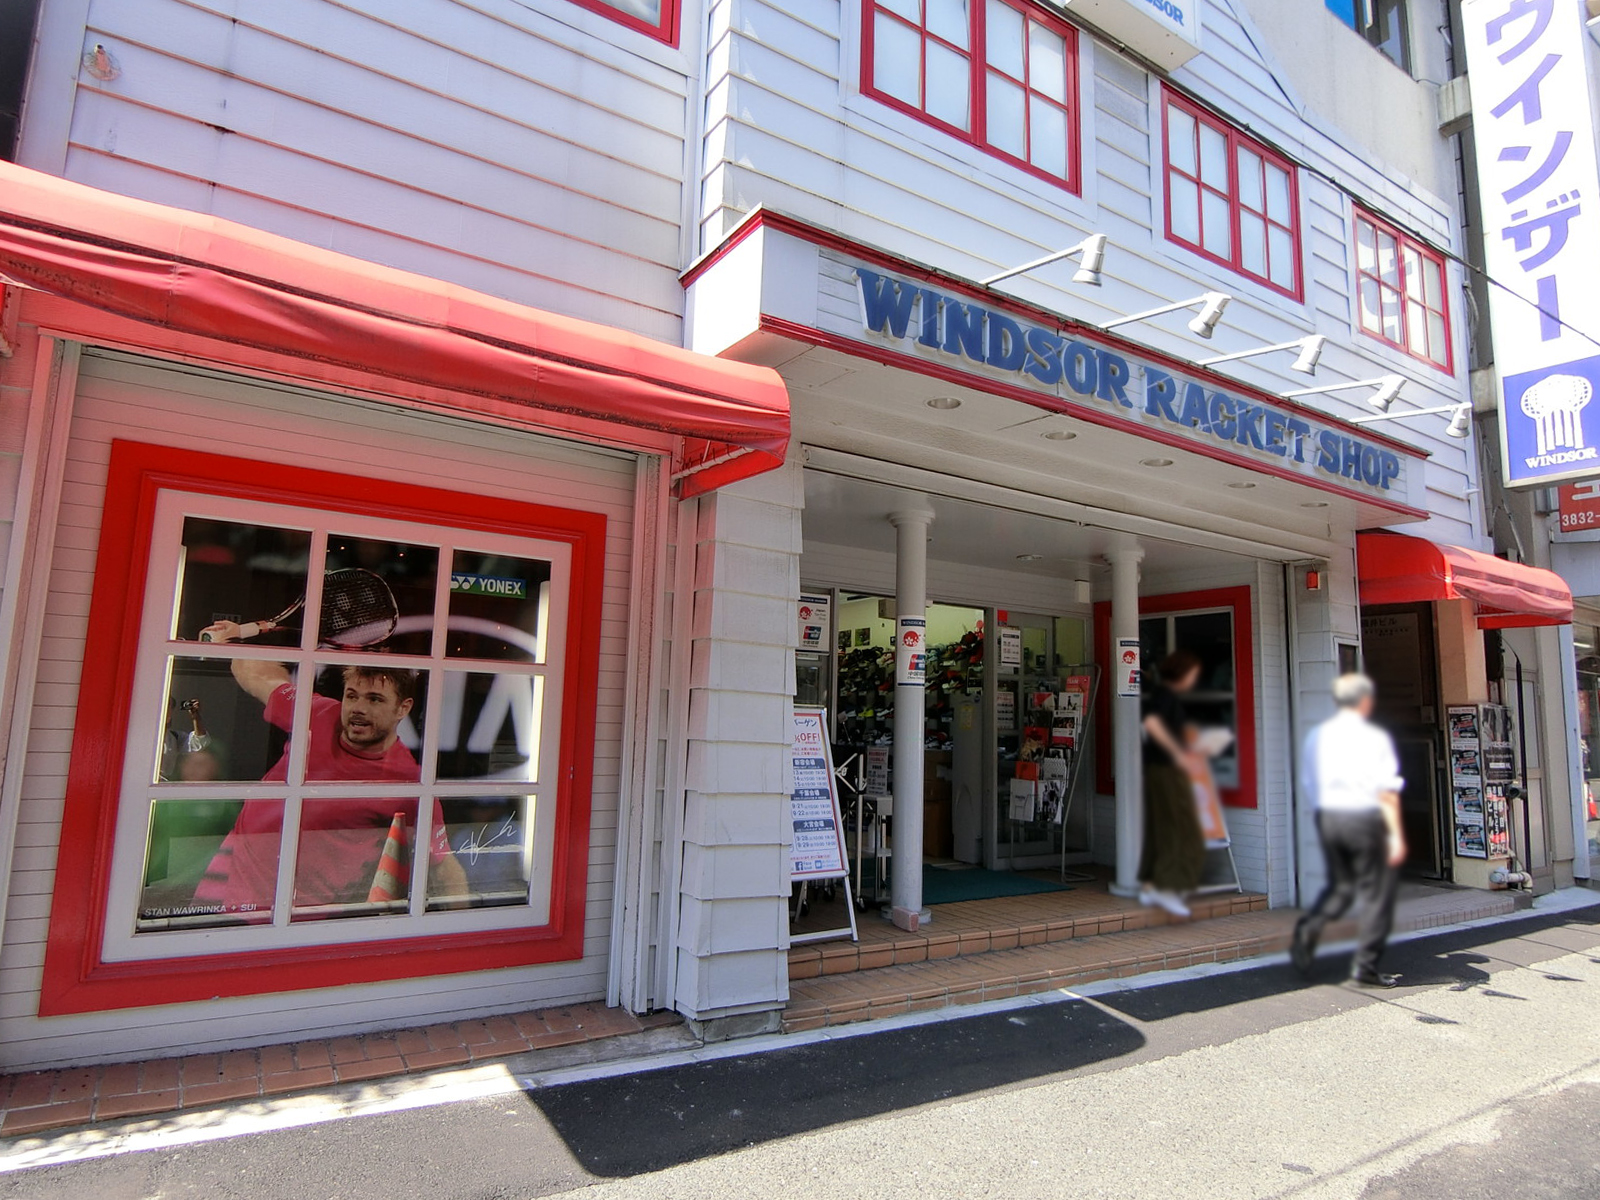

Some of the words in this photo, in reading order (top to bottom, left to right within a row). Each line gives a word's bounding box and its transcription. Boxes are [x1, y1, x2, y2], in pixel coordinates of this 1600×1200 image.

[853, 267, 1134, 409] WINDSOR
[1140, 366, 1310, 464] RACKET
[1315, 429, 1400, 490] SHOP
[1525, 447, 1599, 469] WINDSOR
[479, 577, 522, 595] YONEX
[145, 908, 171, 917] STAN
[173, 904, 227, 915] WAWRINKA
[241, 903, 257, 911] SUI
